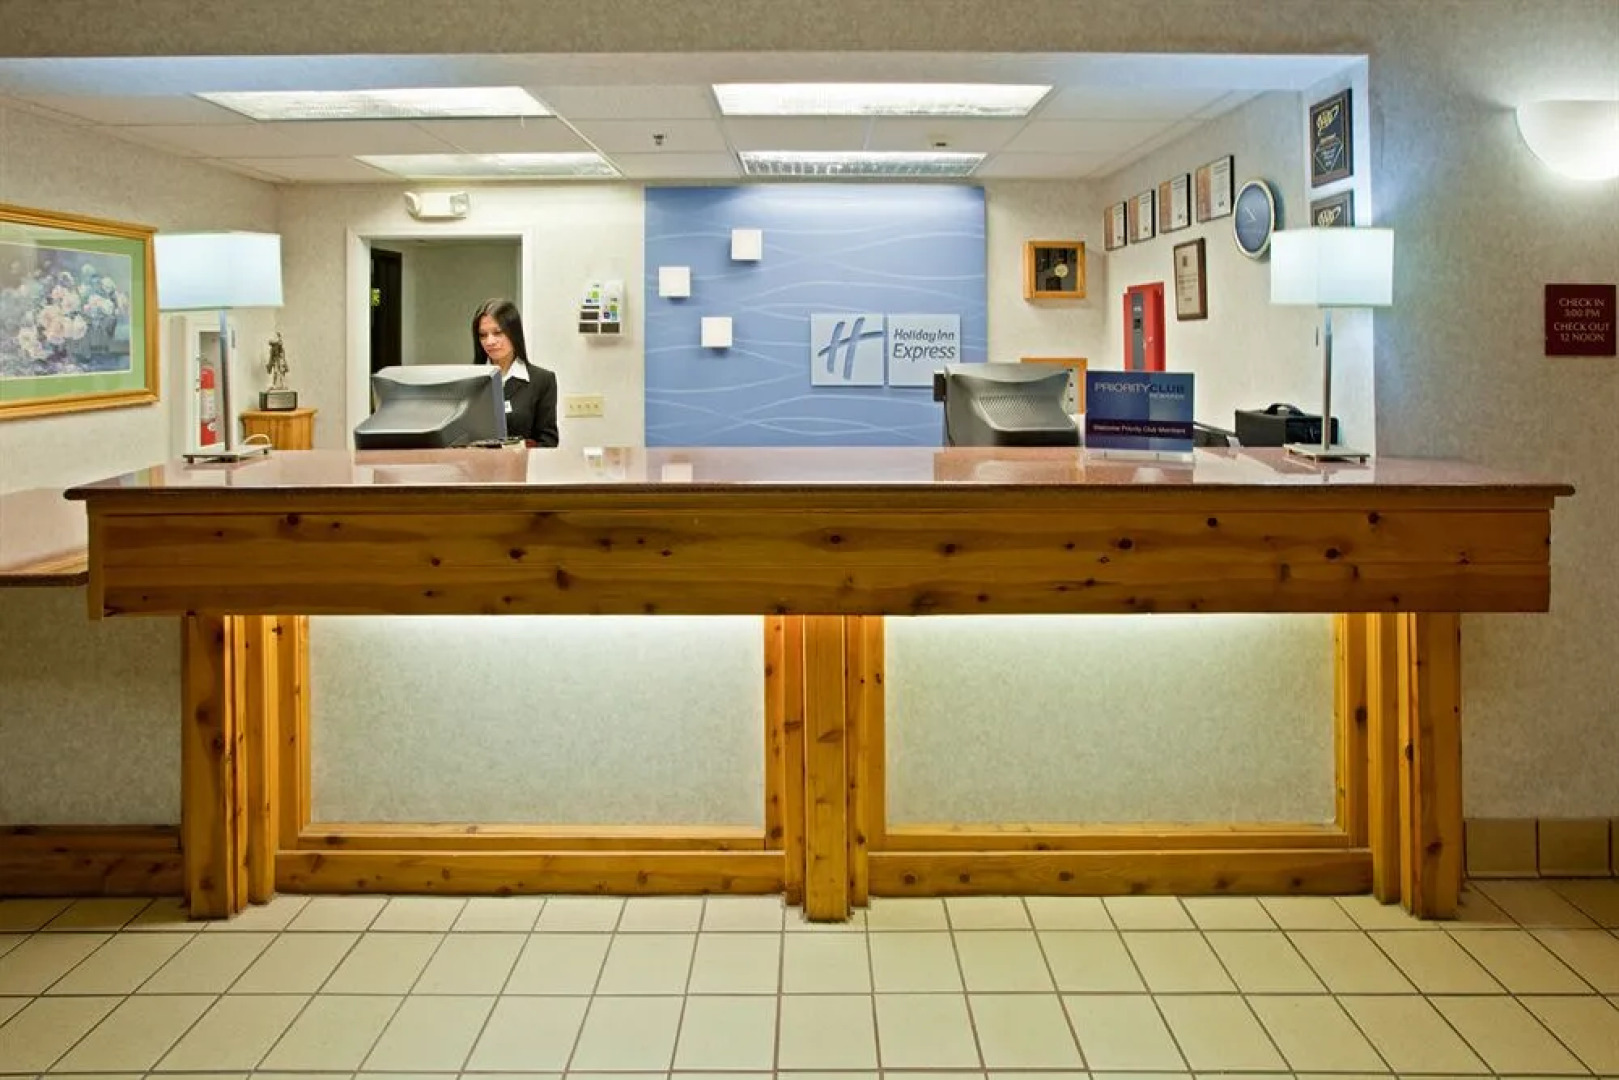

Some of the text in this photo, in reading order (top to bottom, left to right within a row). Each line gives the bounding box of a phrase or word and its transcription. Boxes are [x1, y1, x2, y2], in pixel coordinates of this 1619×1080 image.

[1559, 298, 1605, 307] CHECK IN
[1585, 308, 1601, 318] PM
[1553, 322, 1609, 331] CHECK OUT
[894, 328, 954, 342] Holiday Inn
[1572, 333, 1605, 342] NOON
[893, 343, 956, 361] Express
[1094, 382, 1184, 393] PRIORITY CLUB
